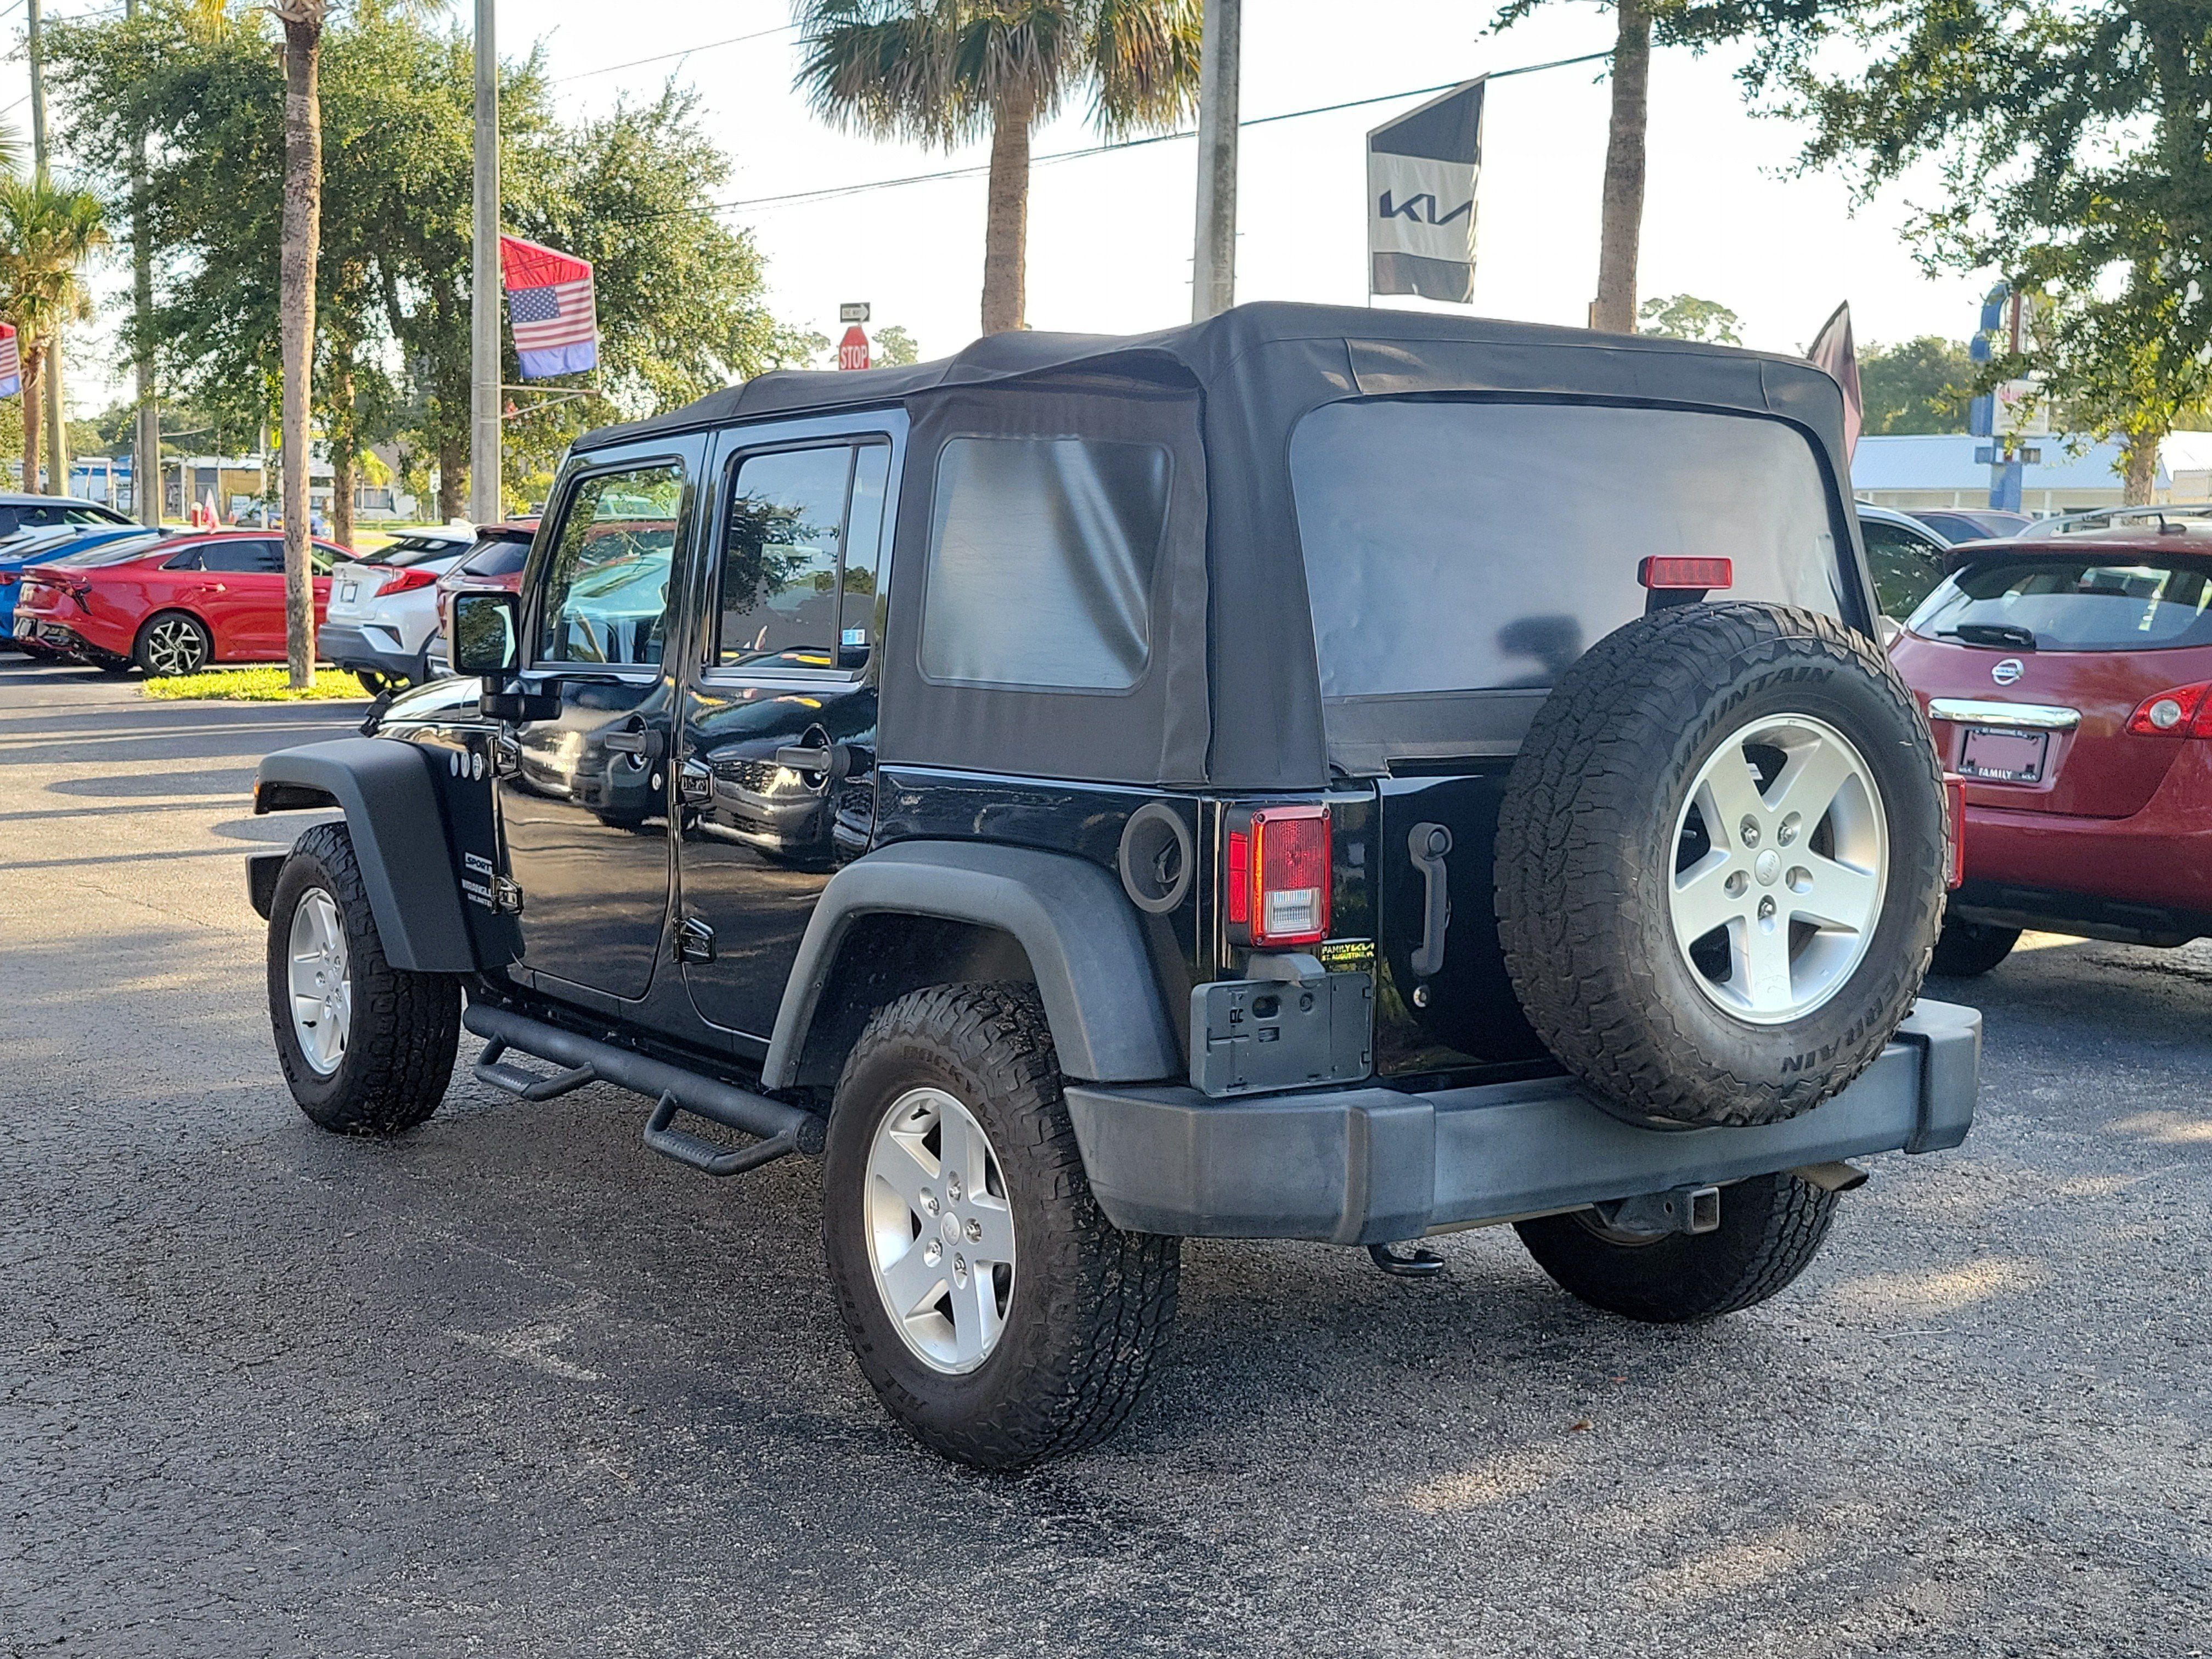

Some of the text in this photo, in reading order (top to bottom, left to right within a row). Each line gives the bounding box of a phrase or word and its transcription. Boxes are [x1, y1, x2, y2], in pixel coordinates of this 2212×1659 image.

[840, 345, 867, 369] STOP
[1672, 666, 1834, 786] MOUNTAIN
[1978, 767, 2012, 780] FAMILY
[467, 856, 490, 872] SPORT
[1322, 944, 1350, 955] FAMILY
